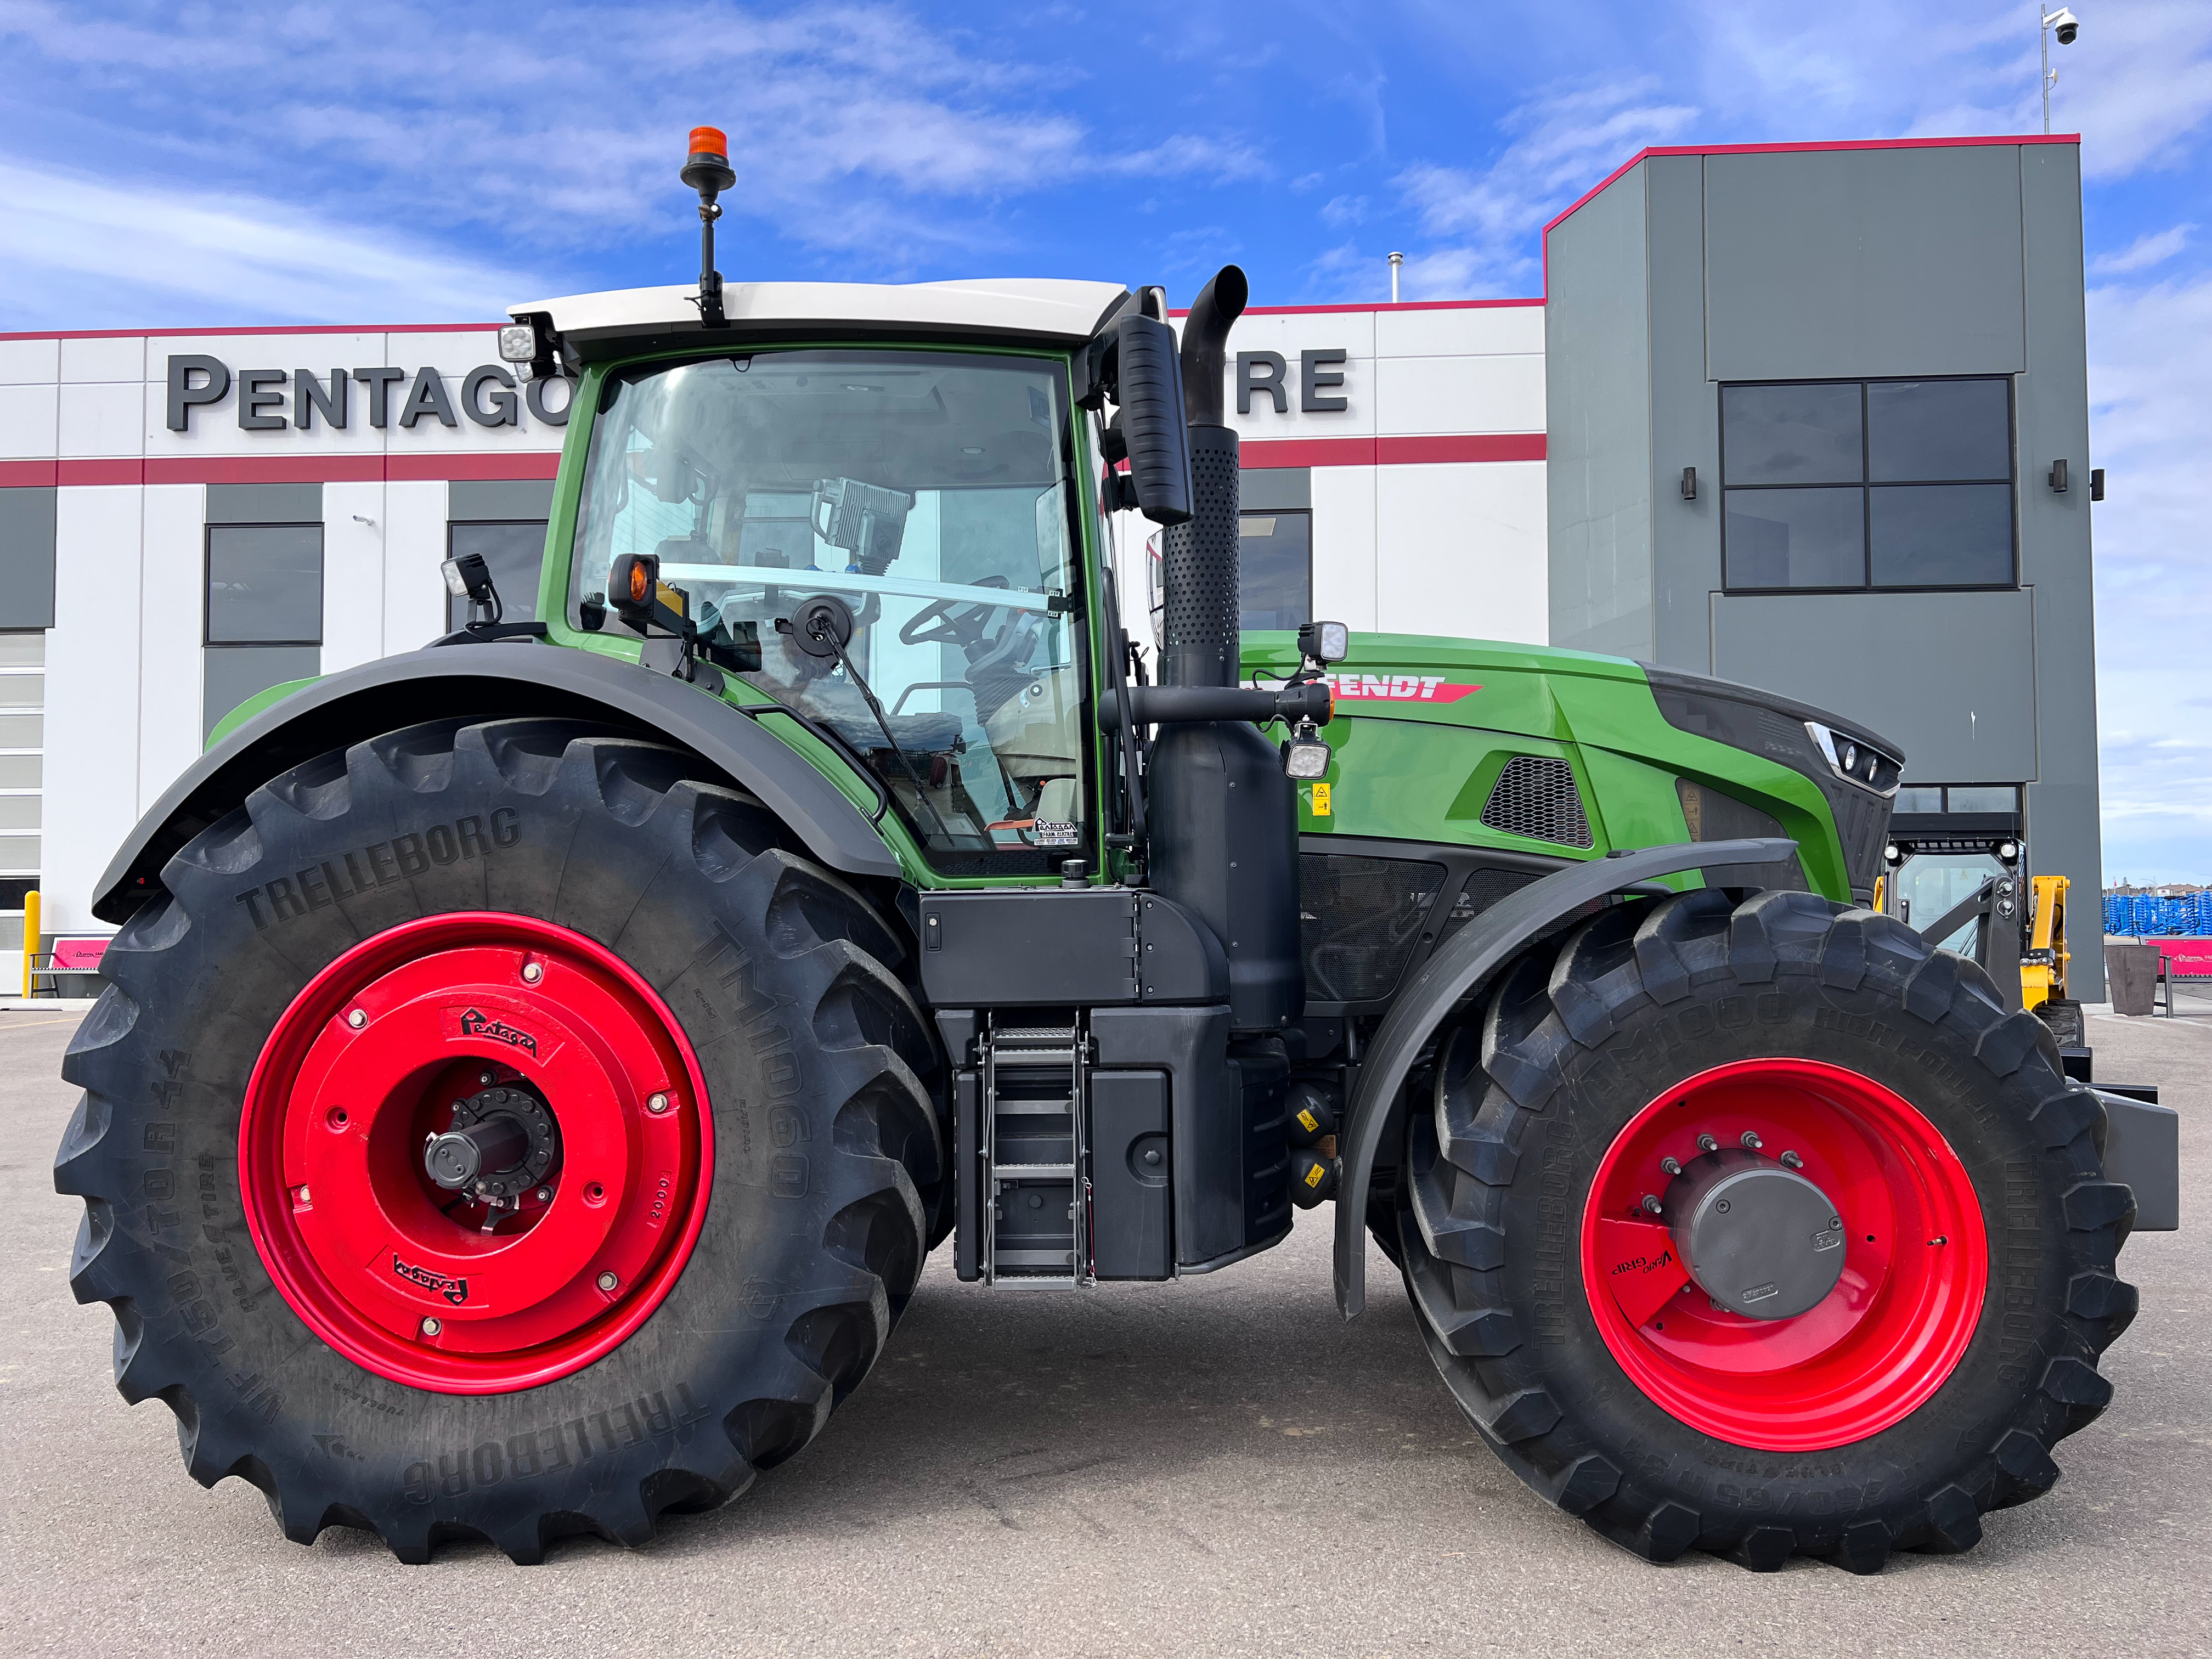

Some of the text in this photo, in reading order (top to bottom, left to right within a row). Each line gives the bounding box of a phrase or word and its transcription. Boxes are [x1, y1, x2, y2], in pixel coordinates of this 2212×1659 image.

[1316, 673, 1446, 699] FENDT
[235, 805, 523, 932] TRELLEBORG
[1035, 817, 1076, 832] Pentagon
[694, 915, 811, 1200] TM1060
[1582, 992, 1793, 1097] TM1000
[1813, 1006, 2001, 1132] HIGH POWER
[738, 1098, 751, 1154] RADIAL
[142, 1048, 287, 1425] VF 750/70 R 44
[198, 1152, 259, 1314] BLUE TIRE
[650, 1177, 670, 1219] 2000
[1531, 1119, 1572, 1350] TRELLEBORG
[1612, 1257, 1647, 1276] GRIP
[1998, 1154, 2041, 1391] TRELLEBORG
[402, 1380, 712, 1505] TRELLEBORG
